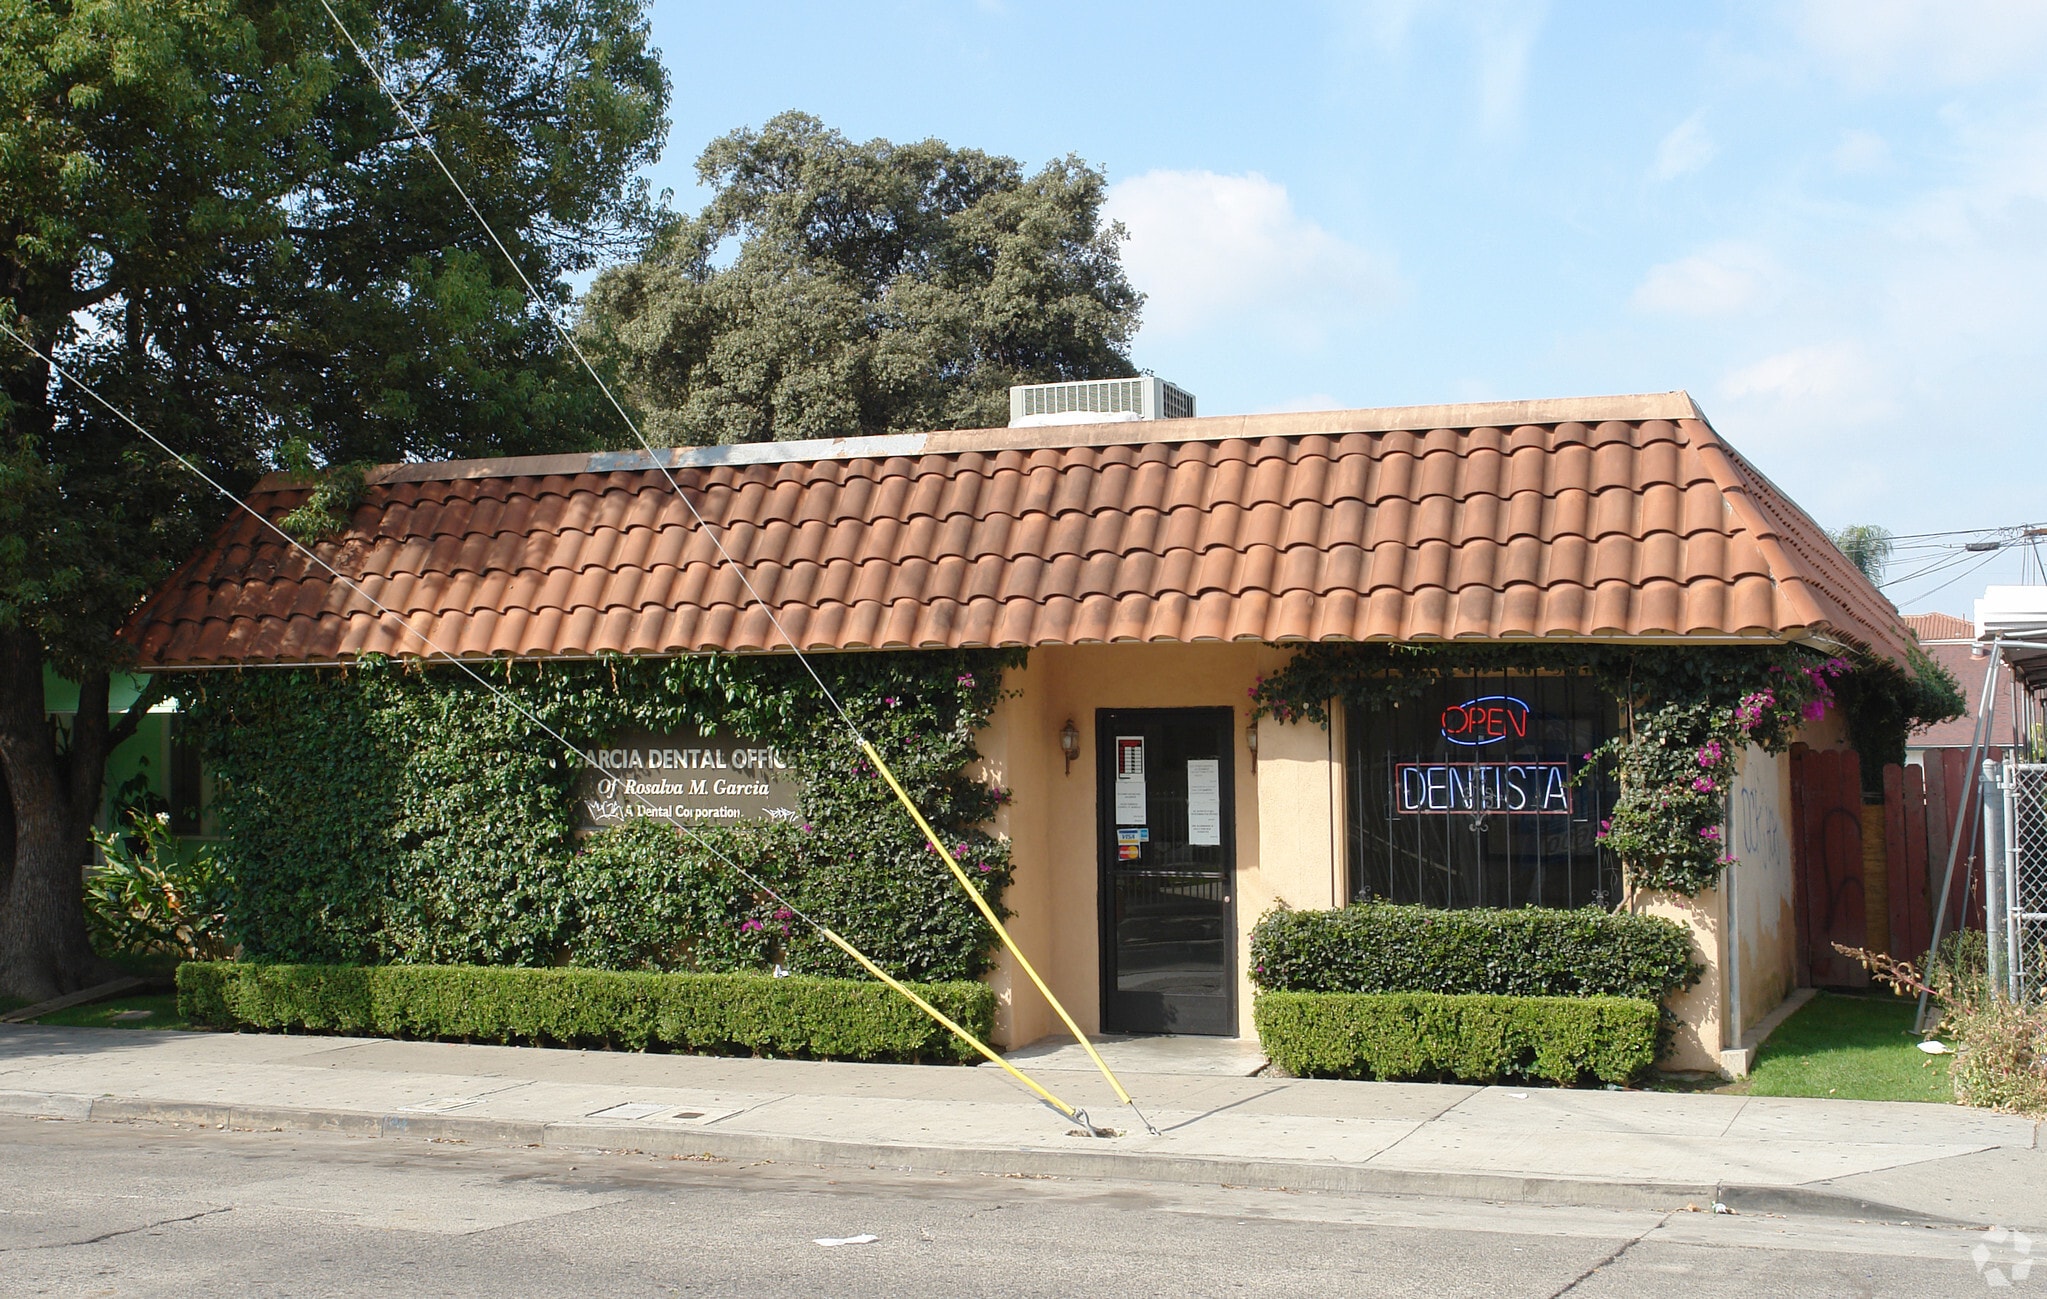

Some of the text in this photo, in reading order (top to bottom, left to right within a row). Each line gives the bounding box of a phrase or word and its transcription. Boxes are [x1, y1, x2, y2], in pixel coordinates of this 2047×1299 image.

[1441, 705, 1527, 738] OPEN
[648, 749, 727, 769] DENTAL
[598, 778, 770, 799] Of Rosalva M. Garcia
[1403, 766, 1569, 811] DENTISTA
[625, 804, 634, 818] A
[637, 805, 673, 818] Dental
[675, 804, 740, 820] Corporation
